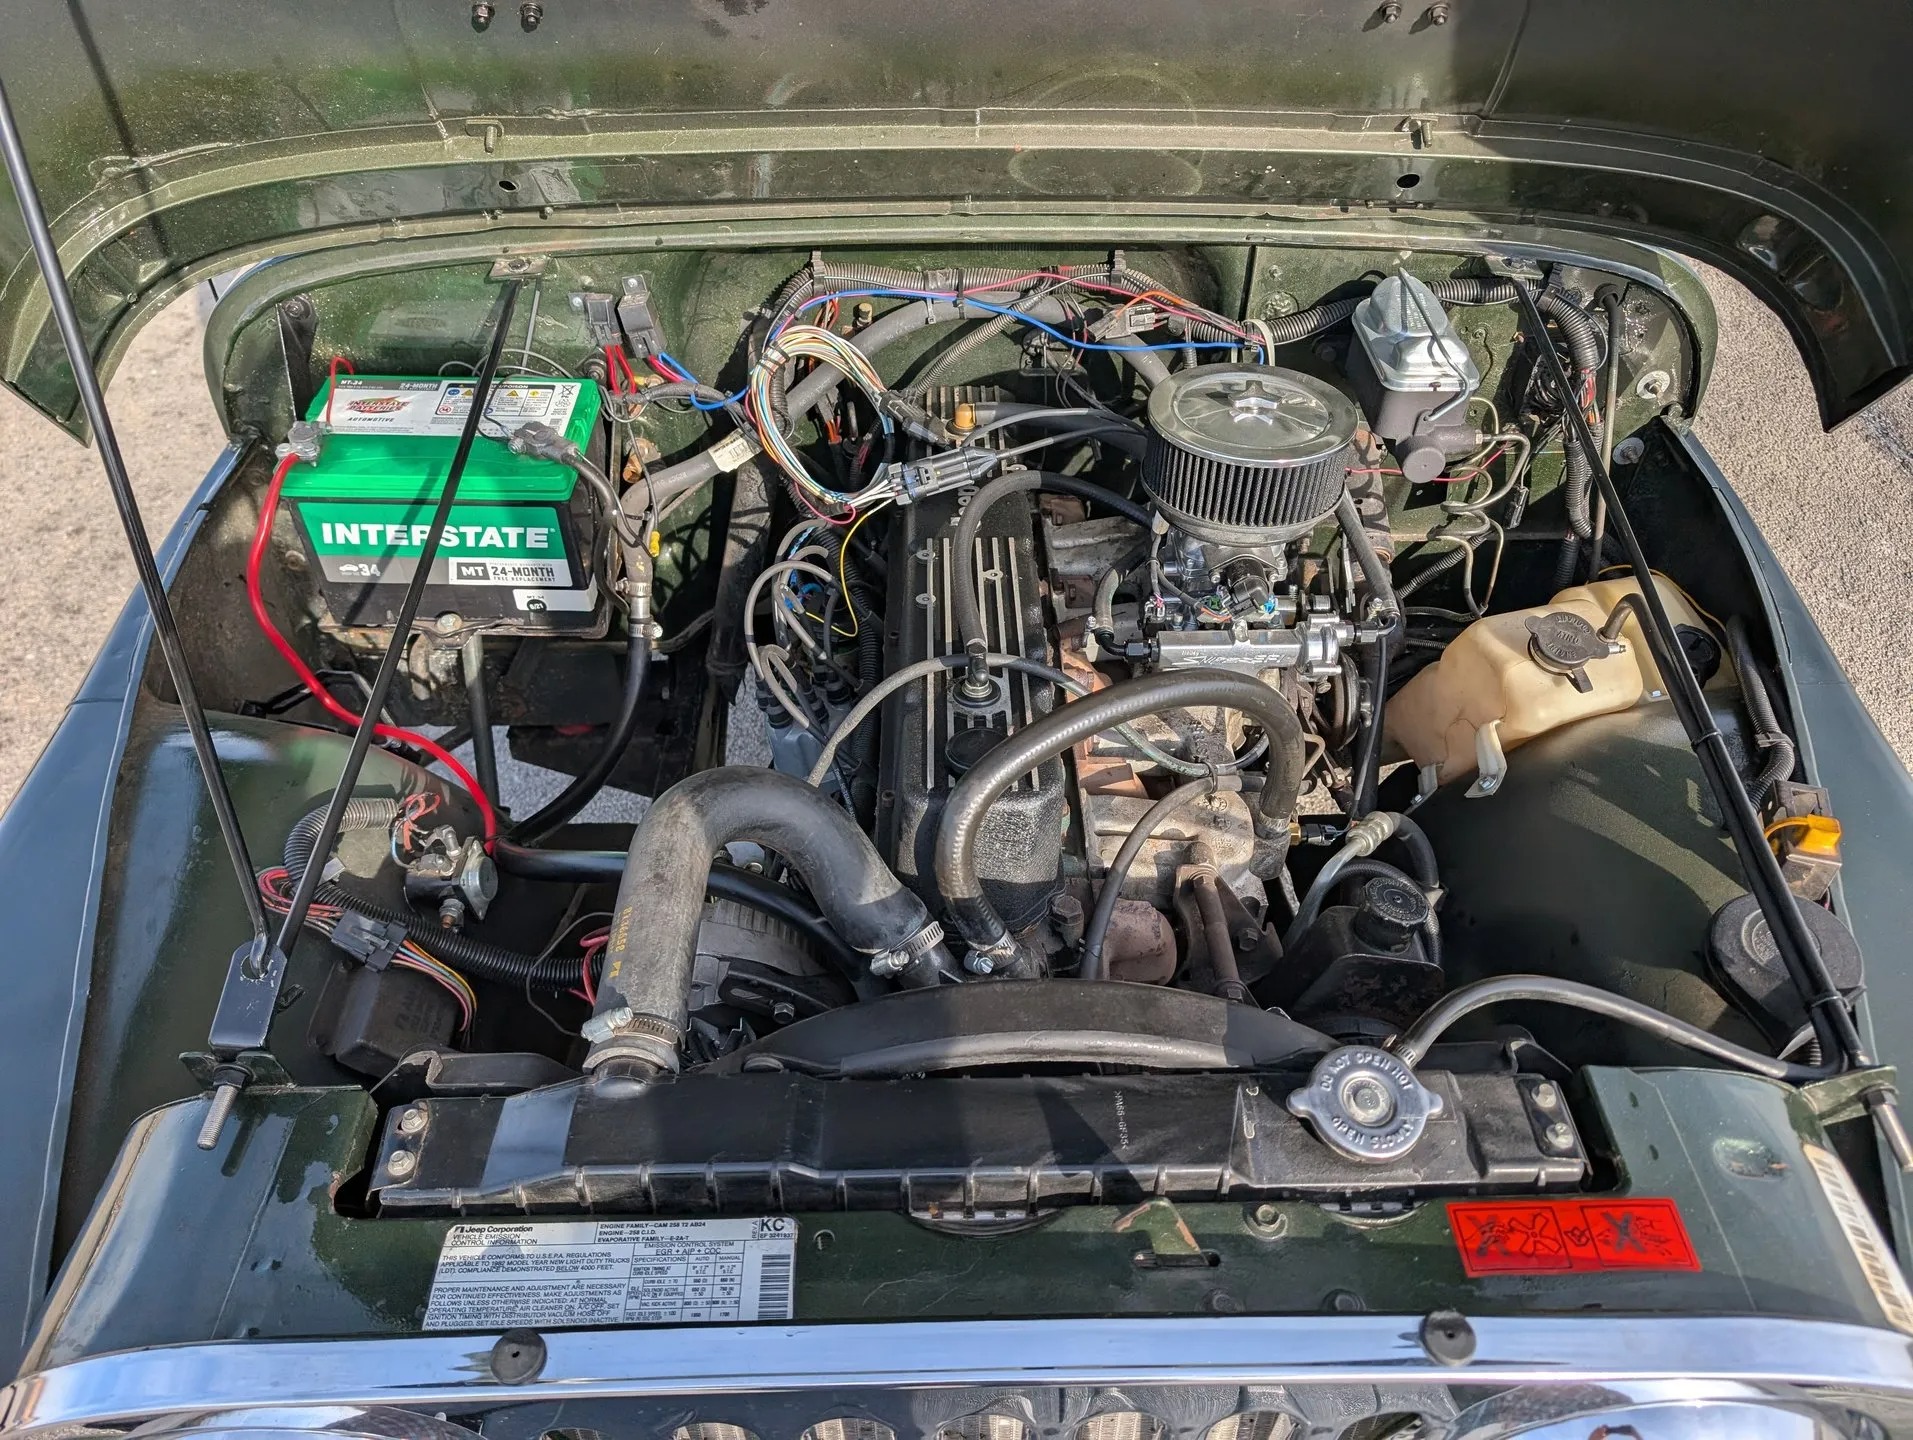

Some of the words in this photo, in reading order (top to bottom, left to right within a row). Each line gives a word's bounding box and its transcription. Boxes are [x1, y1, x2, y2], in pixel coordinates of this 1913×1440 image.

[322, 522, 548, 548] INTERSTATE
[358, 564, 380, 576] 34
[460, 566, 484, 576] MT
[491, 566, 554, 577] 24-MONTH
[1556, 615, 1590, 634] COOLANT
[1557, 630, 1580, 644] ONLY
[1320, 1074, 1334, 1092] DO
[1330, 1054, 1351, 1074] NOT
[1356, 1052, 1391, 1070] OPEN
[1392, 1066, 1414, 1090] HOT
[1332, 1116, 1365, 1146] OPEN
[1370, 1118, 1414, 1148] SLOWLY
[487, 1225, 533, 1234] Corporation
[760, 1218, 785, 1232] KC
